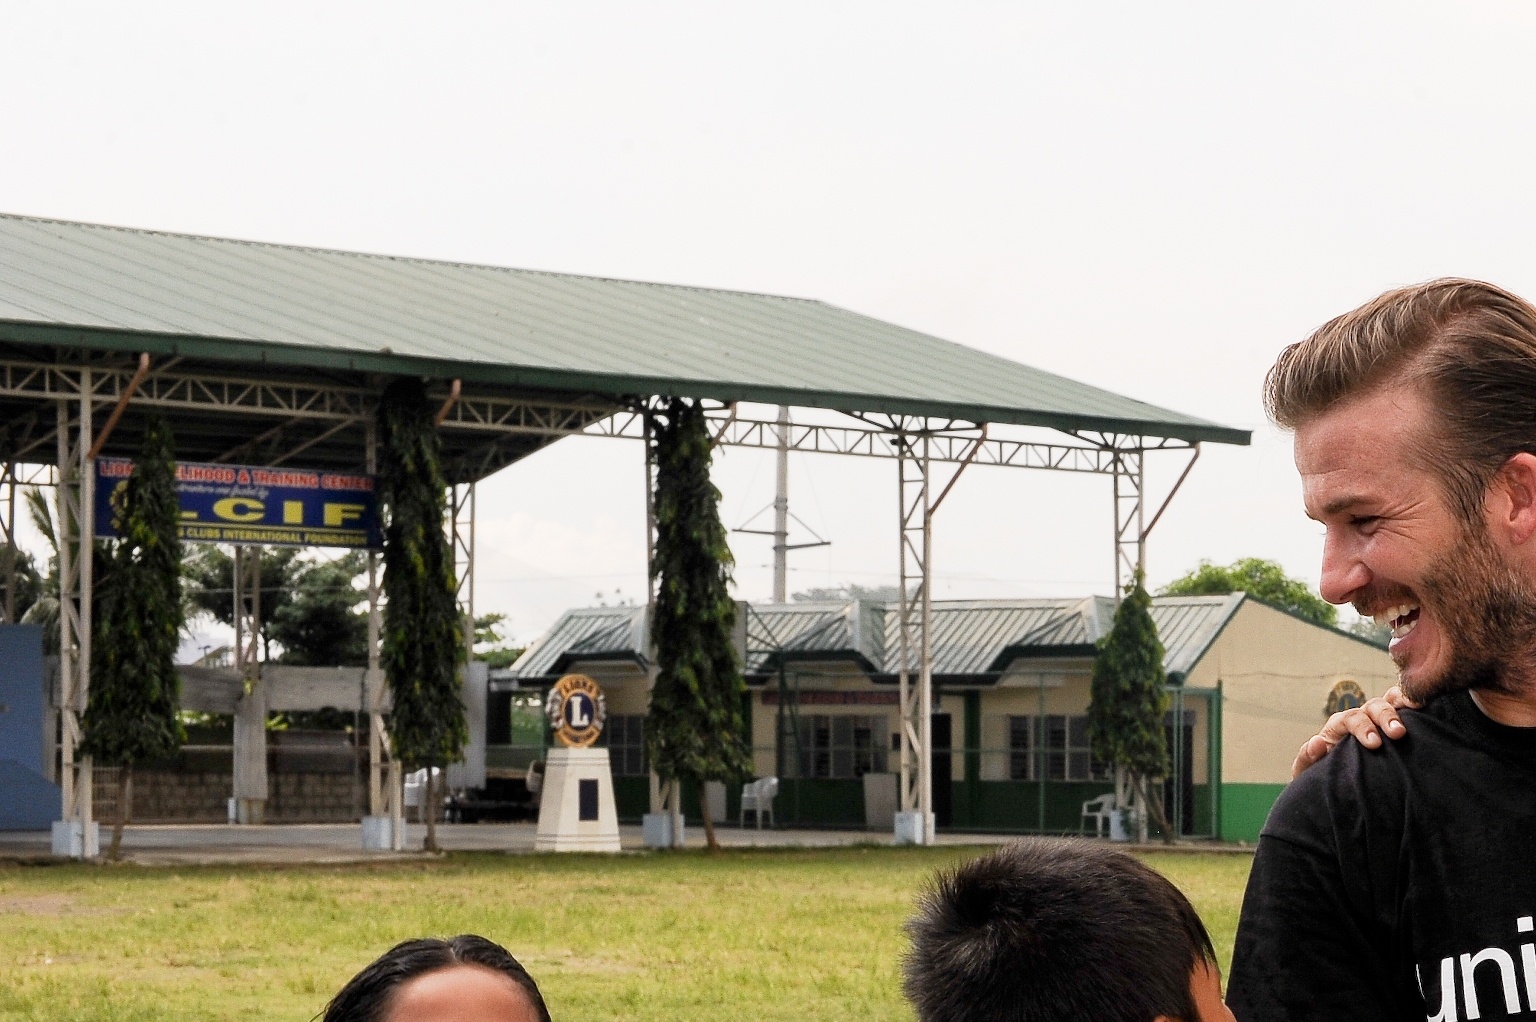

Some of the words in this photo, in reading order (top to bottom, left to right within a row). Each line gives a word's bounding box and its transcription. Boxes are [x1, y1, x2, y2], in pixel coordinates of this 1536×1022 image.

[237, 468, 251, 485] &
[252, 469, 319, 489] TRAINING
[321, 473, 373, 491] CENTER
[186, 527, 221, 539] CLUBS
[222, 529, 302, 543] INTERNATIONAL
[304, 532, 367, 545] FOUNDATION
[570, 696, 589, 727] L
